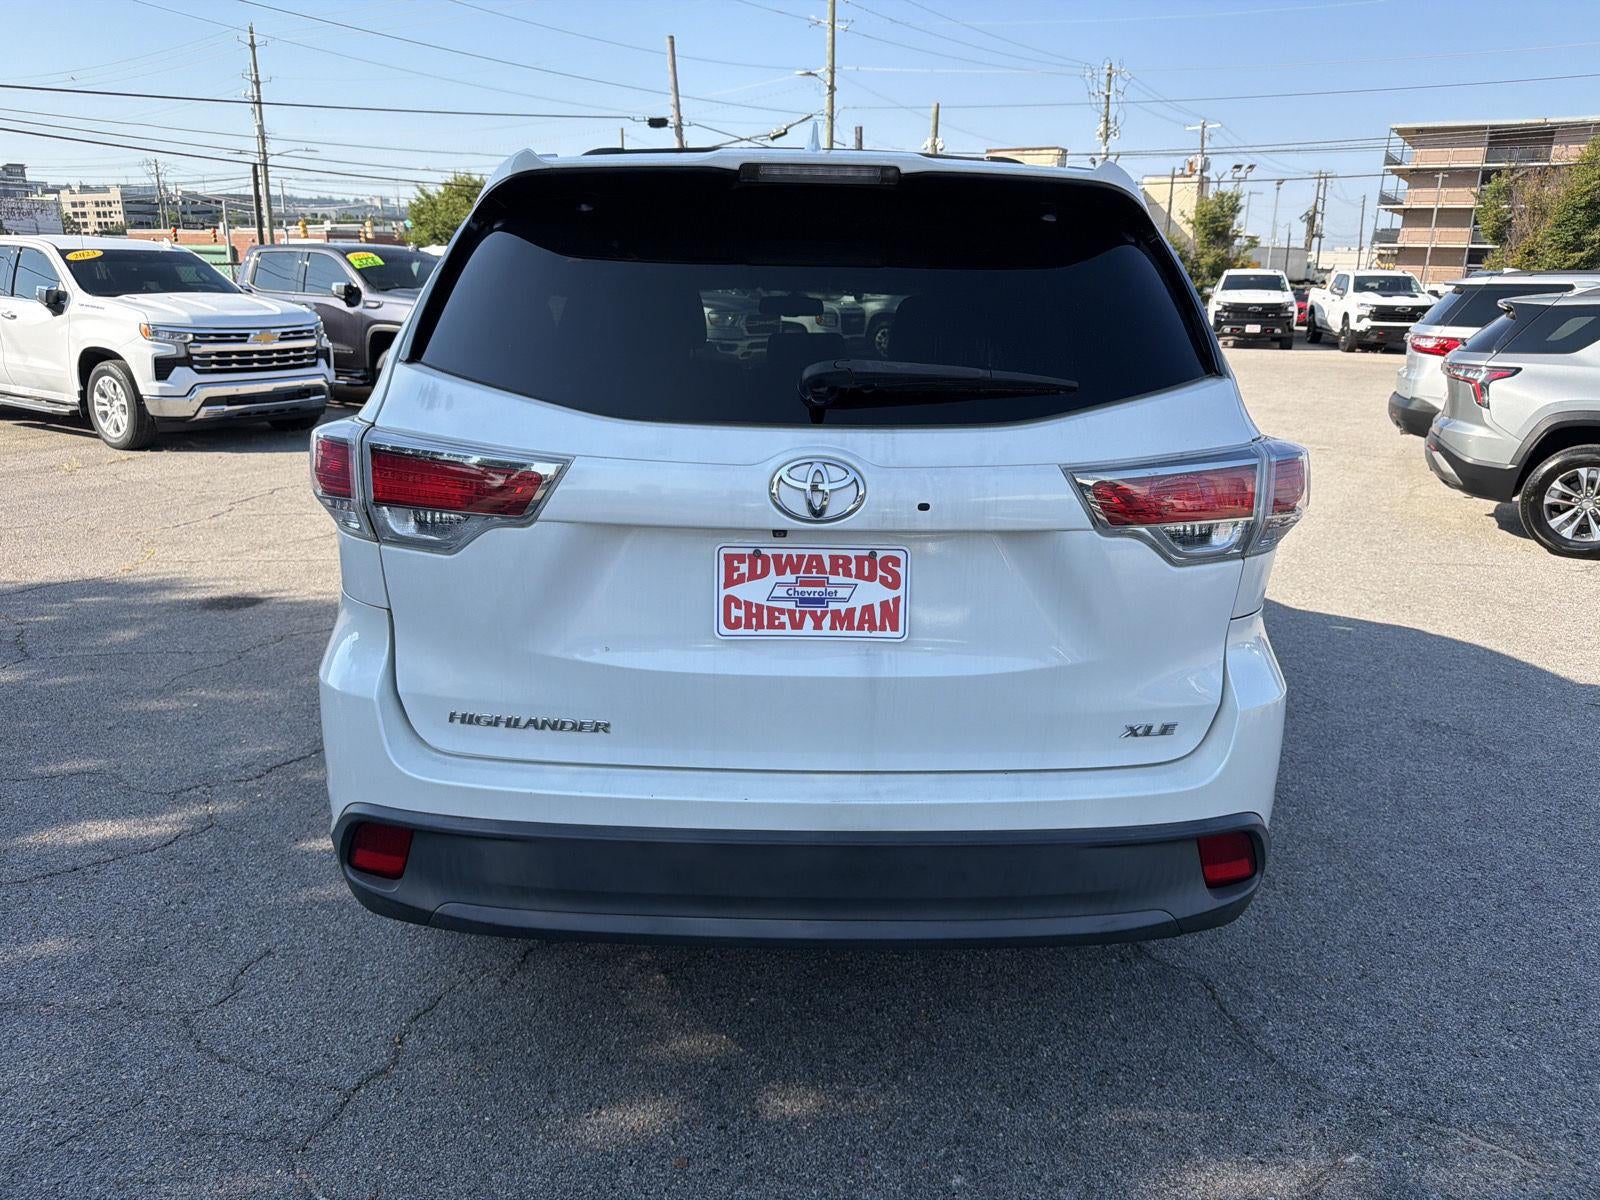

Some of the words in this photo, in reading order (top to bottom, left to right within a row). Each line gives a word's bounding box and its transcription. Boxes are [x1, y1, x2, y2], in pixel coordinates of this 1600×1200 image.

[723, 553, 901, 590] EDWARDS
[786, 587, 838, 597] Chevrolet
[723, 594, 901, 632] CHEVYMAN
[449, 710, 611, 734] HIGHLANDER
[1119, 722, 1179, 738] XLE
